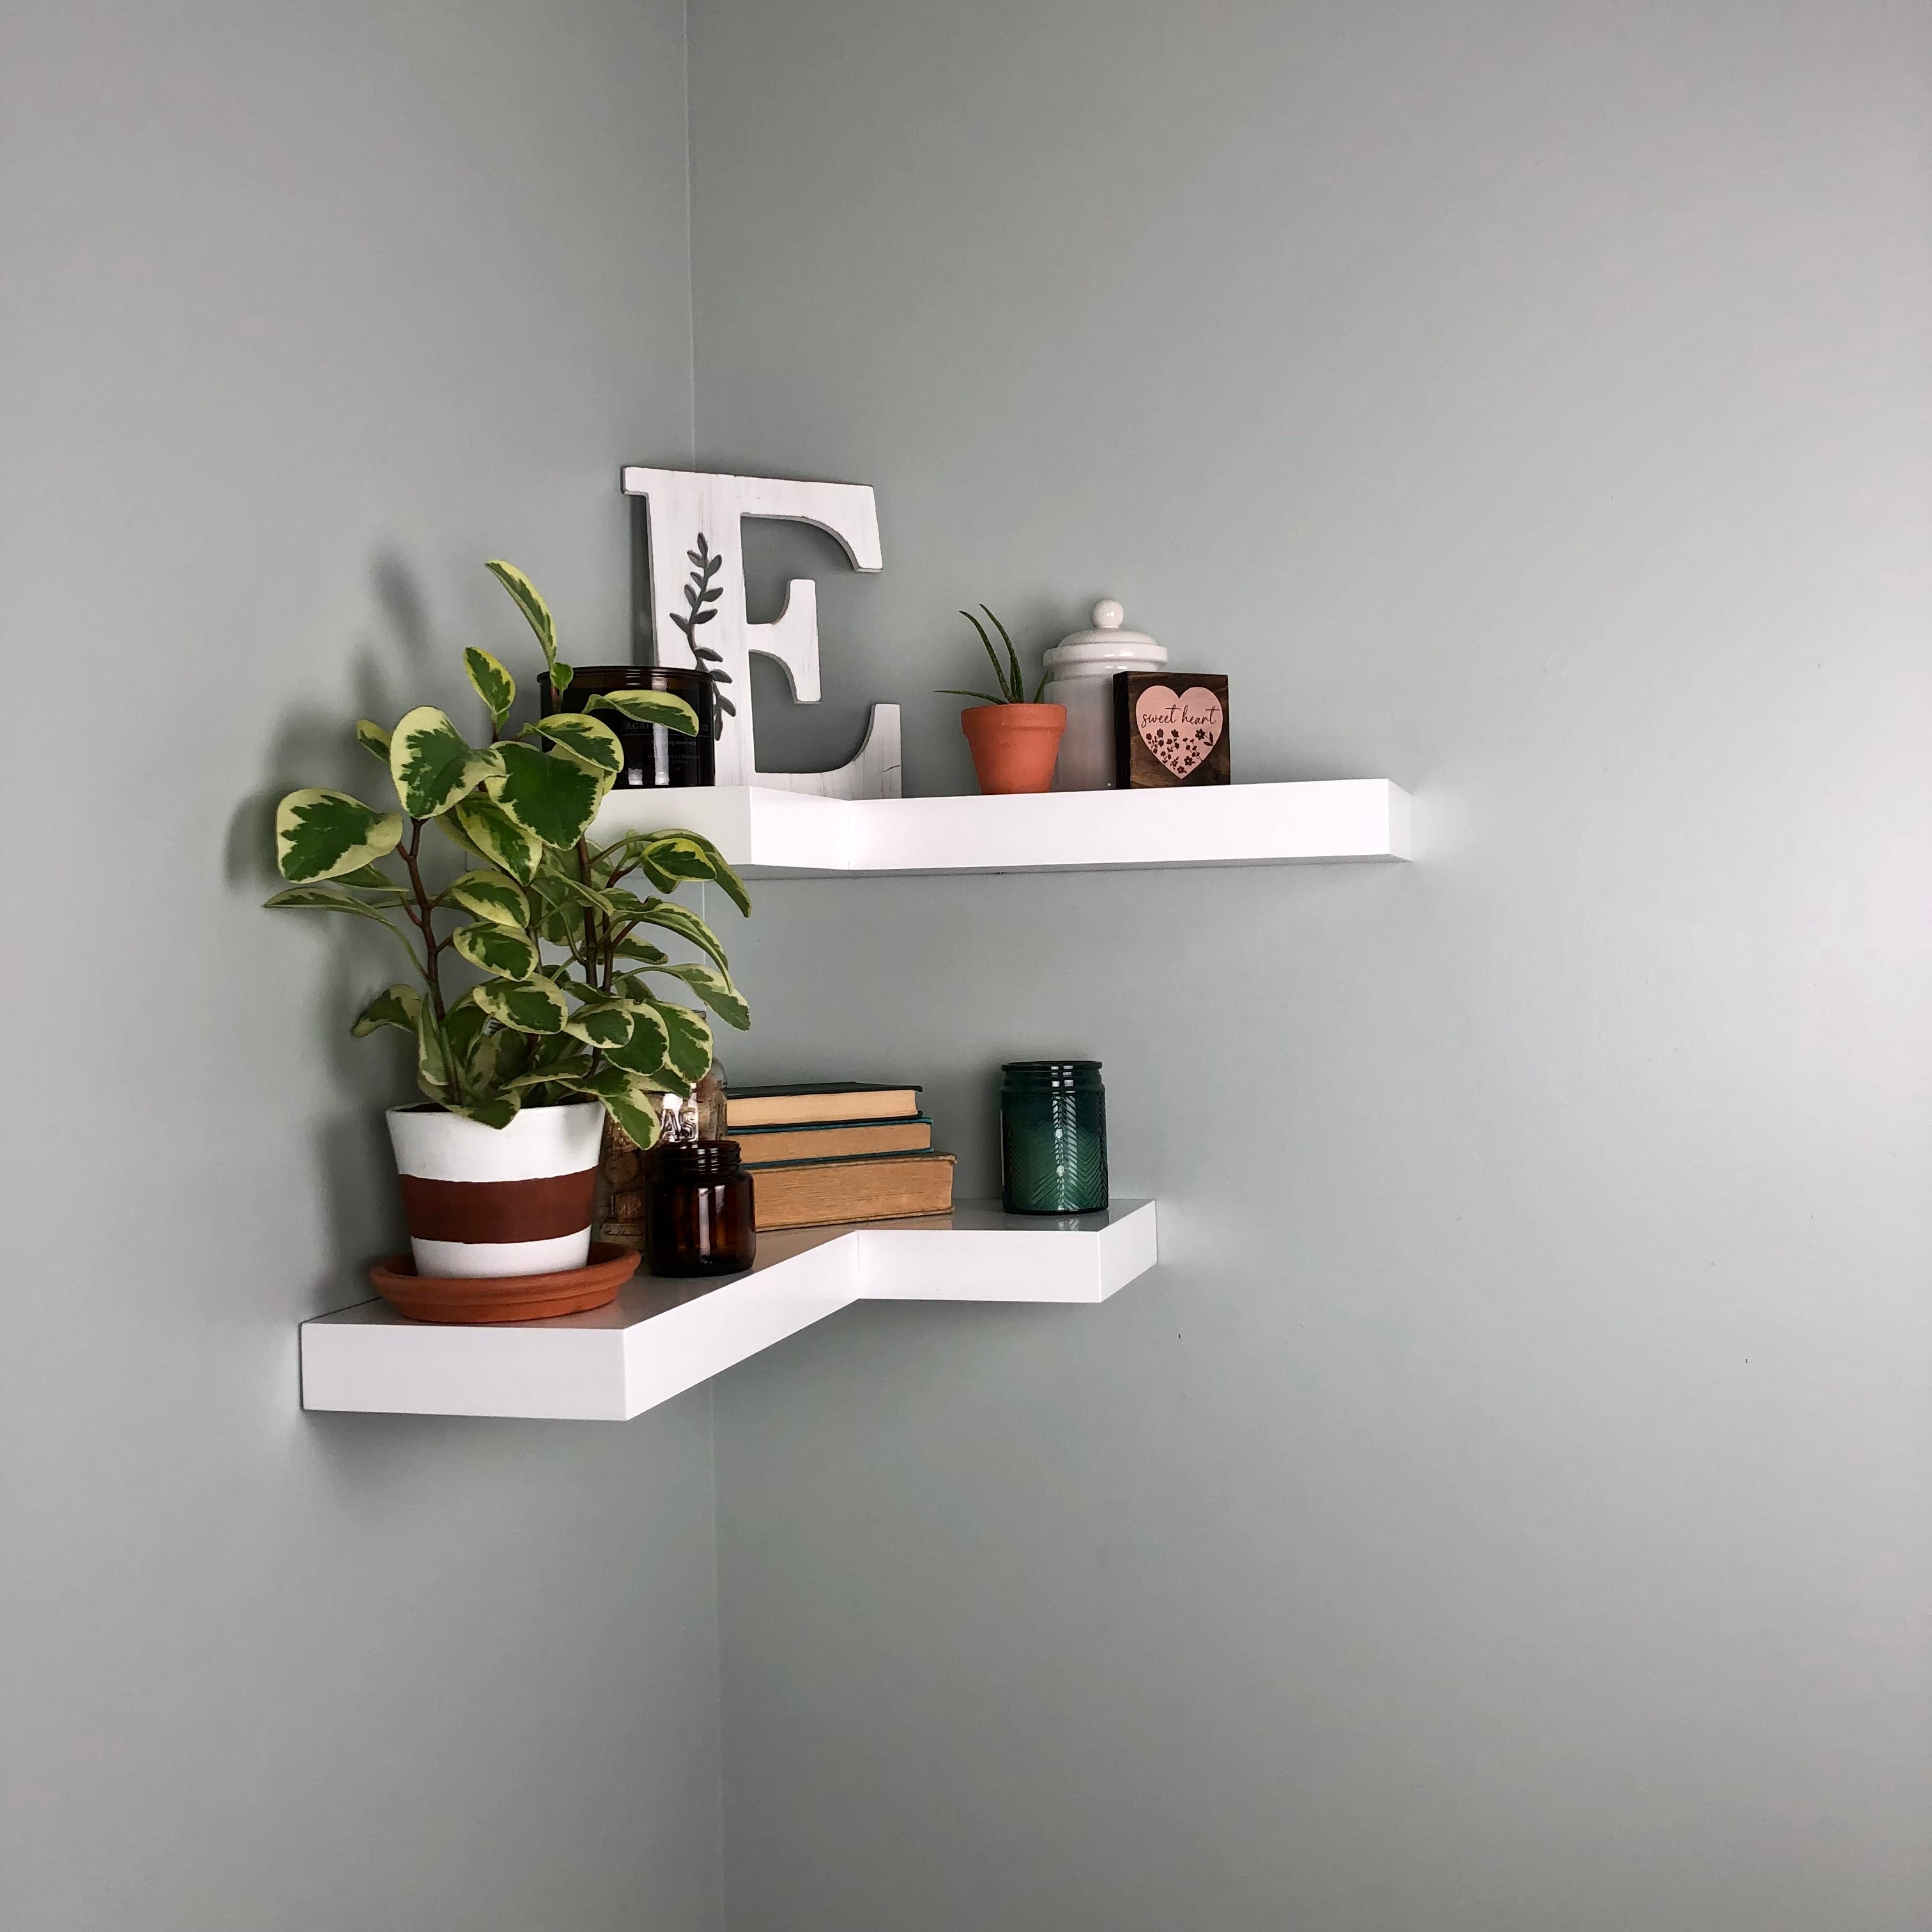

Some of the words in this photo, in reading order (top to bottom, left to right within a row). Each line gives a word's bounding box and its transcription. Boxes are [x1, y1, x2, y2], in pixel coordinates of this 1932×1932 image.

[1141, 704, 1181, 728] sweet
[1182, 705, 1219, 724] heart
[659, 1107, 698, 1143] AS
